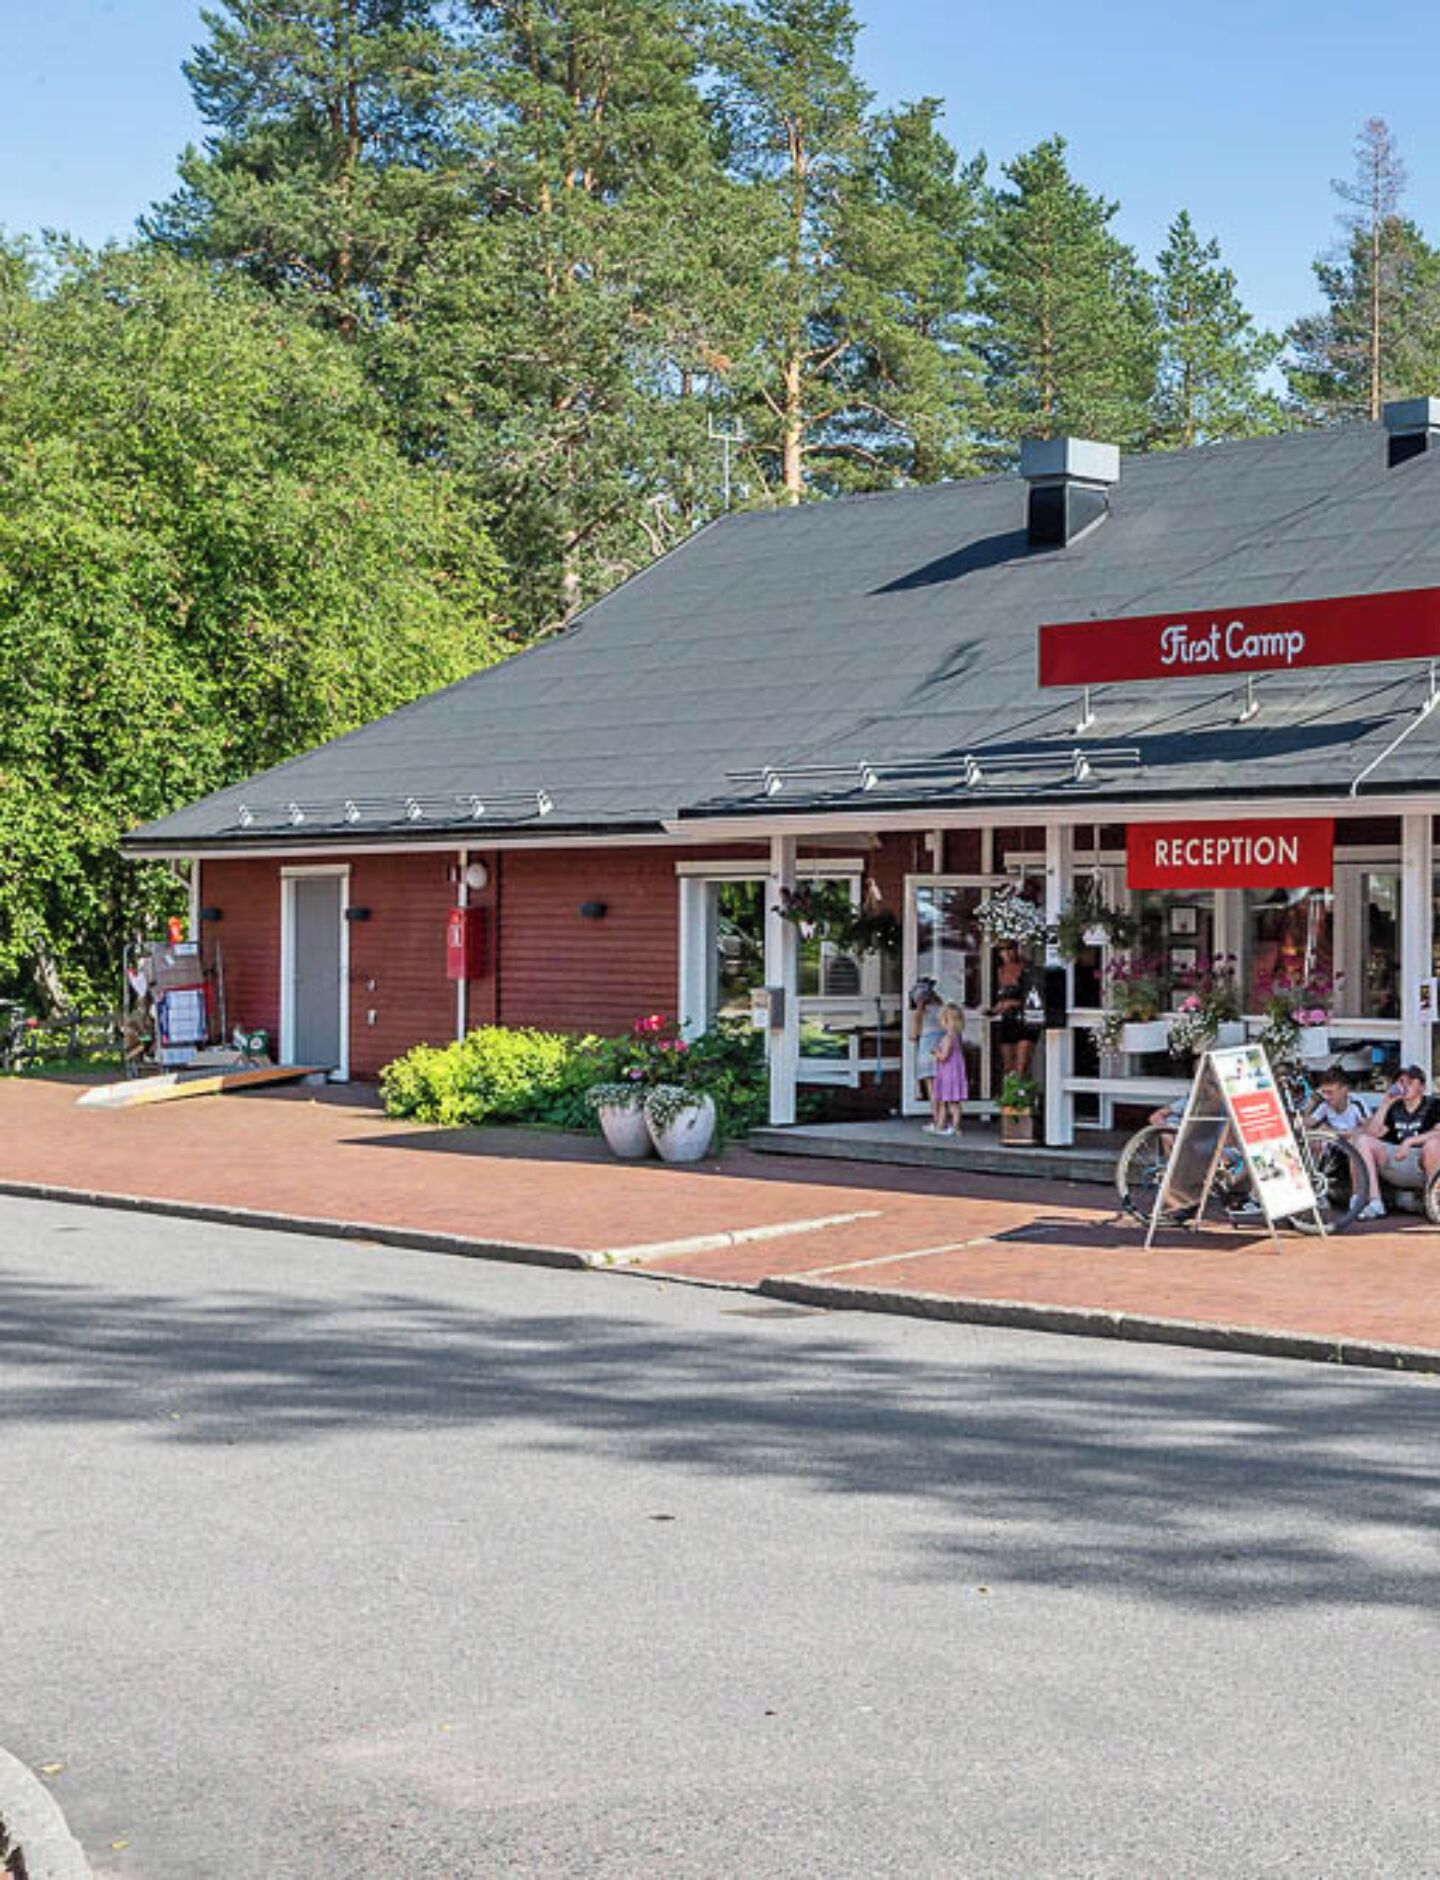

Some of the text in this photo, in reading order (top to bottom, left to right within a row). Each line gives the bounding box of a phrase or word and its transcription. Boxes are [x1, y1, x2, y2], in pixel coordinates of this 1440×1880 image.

[1160, 620, 1305, 664] First Camp
[1154, 836, 1298, 867] RECEPTION
